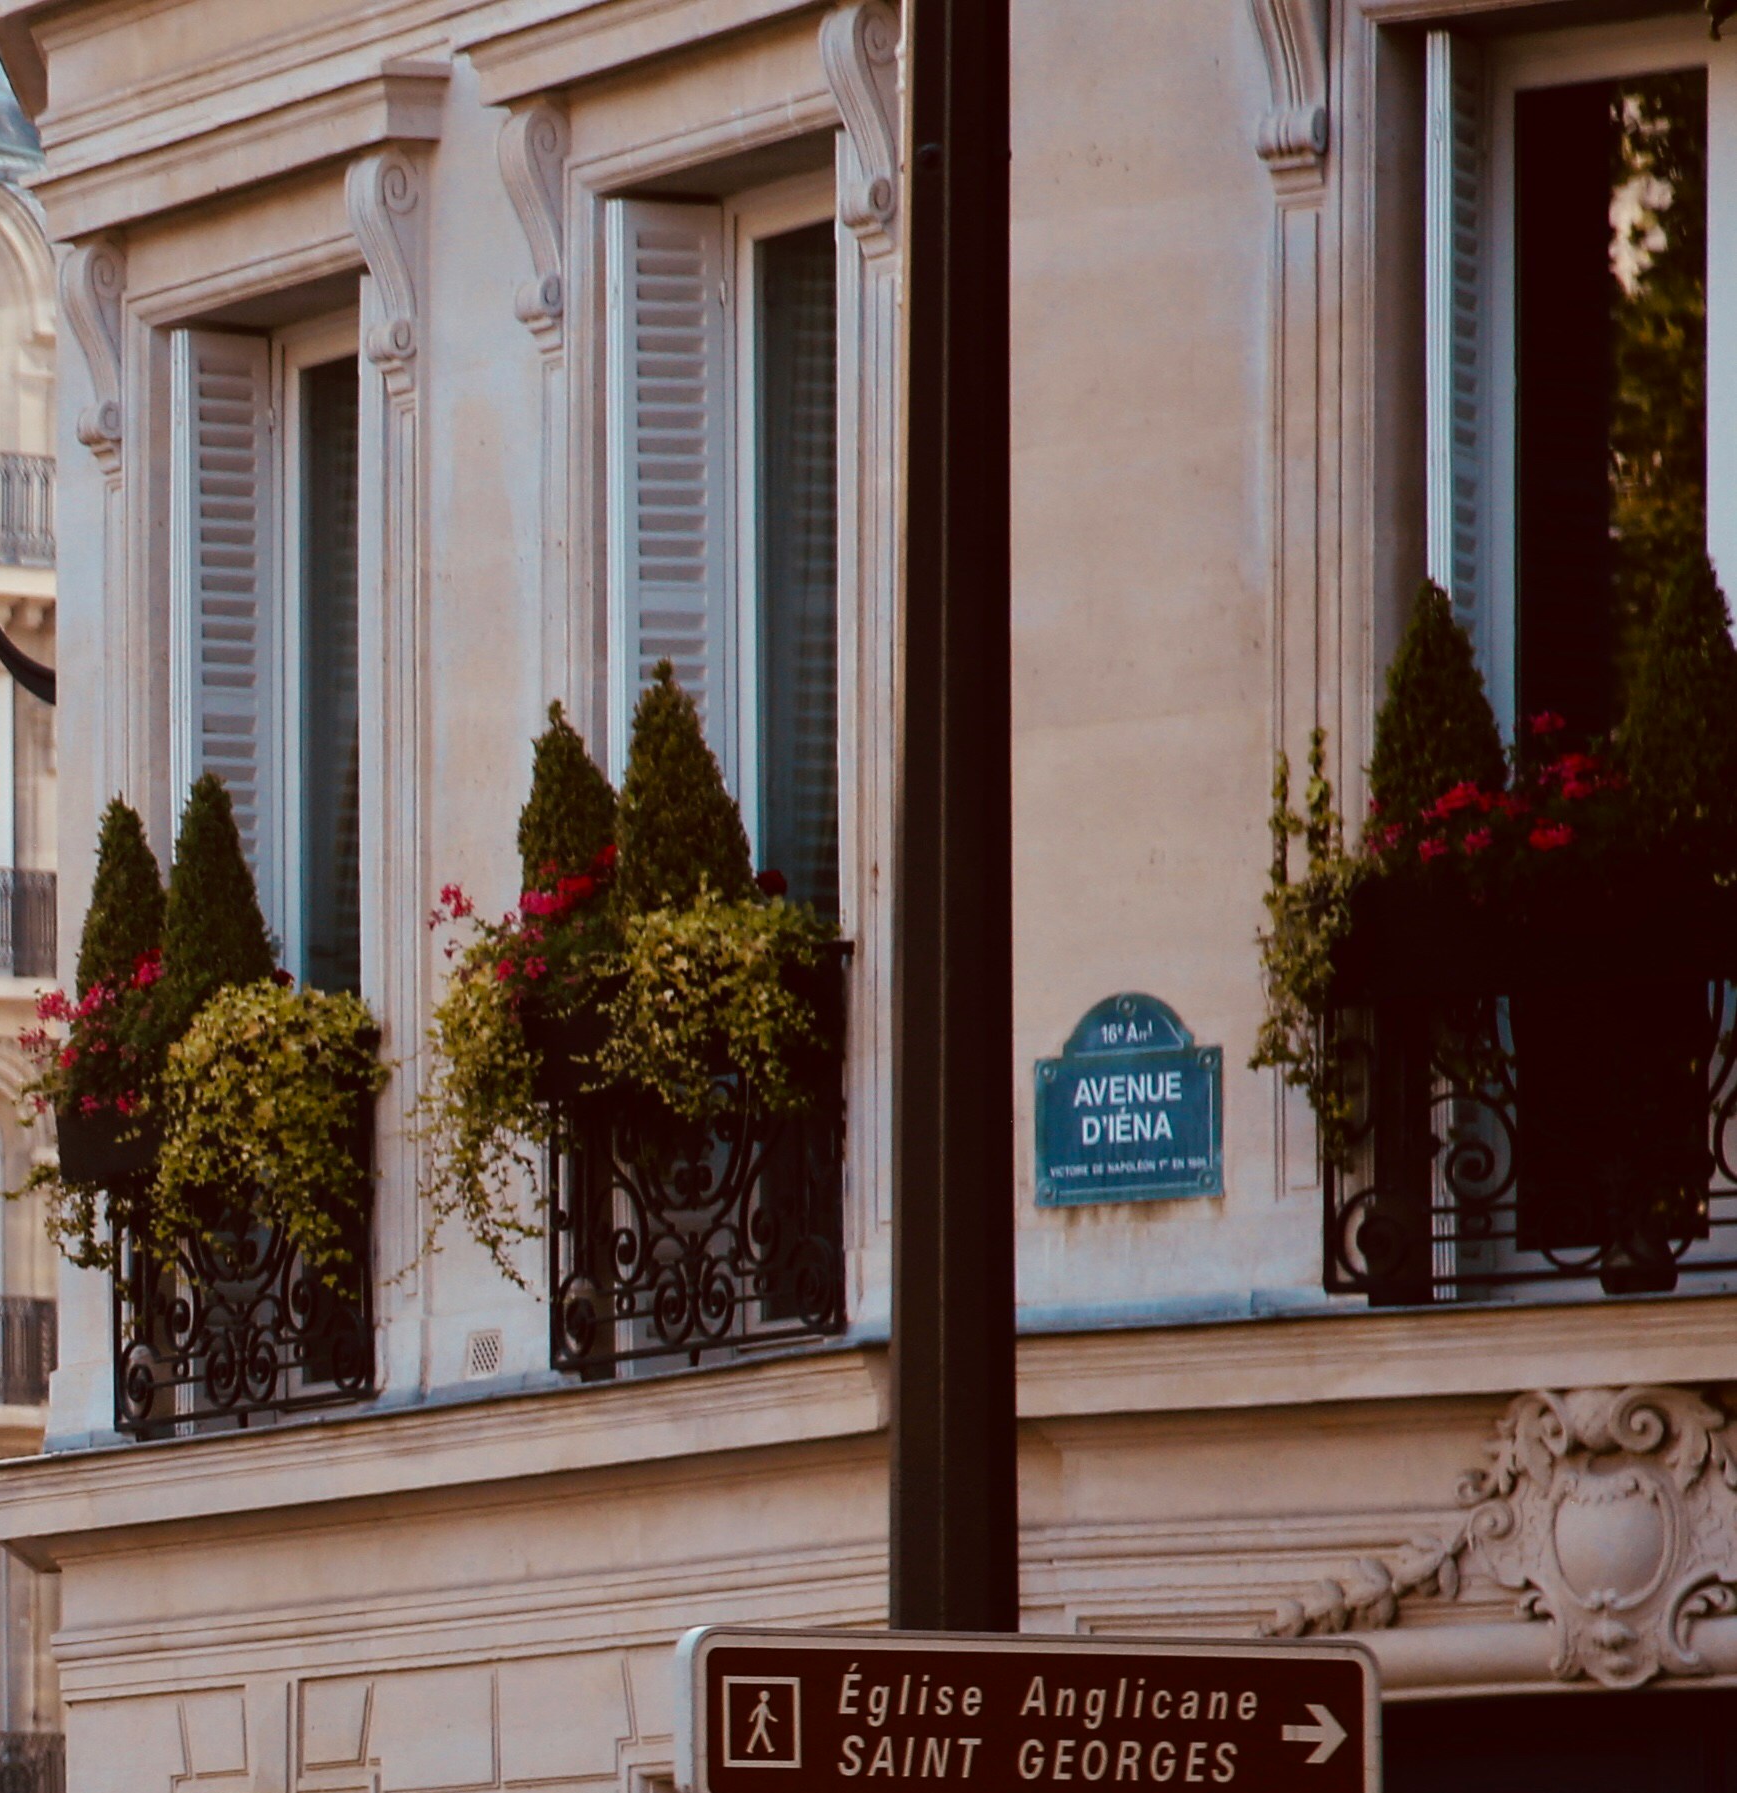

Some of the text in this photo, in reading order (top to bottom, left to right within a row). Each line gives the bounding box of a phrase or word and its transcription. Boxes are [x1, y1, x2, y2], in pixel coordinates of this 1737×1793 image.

[1073, 1071, 1183, 1108] AVENUE
[1082, 1107, 1173, 1145] D'IÉNA
[838, 1663, 1259, 1731] Église Anglicane
[837, 1736, 1239, 1783] SAINT GEORGES
